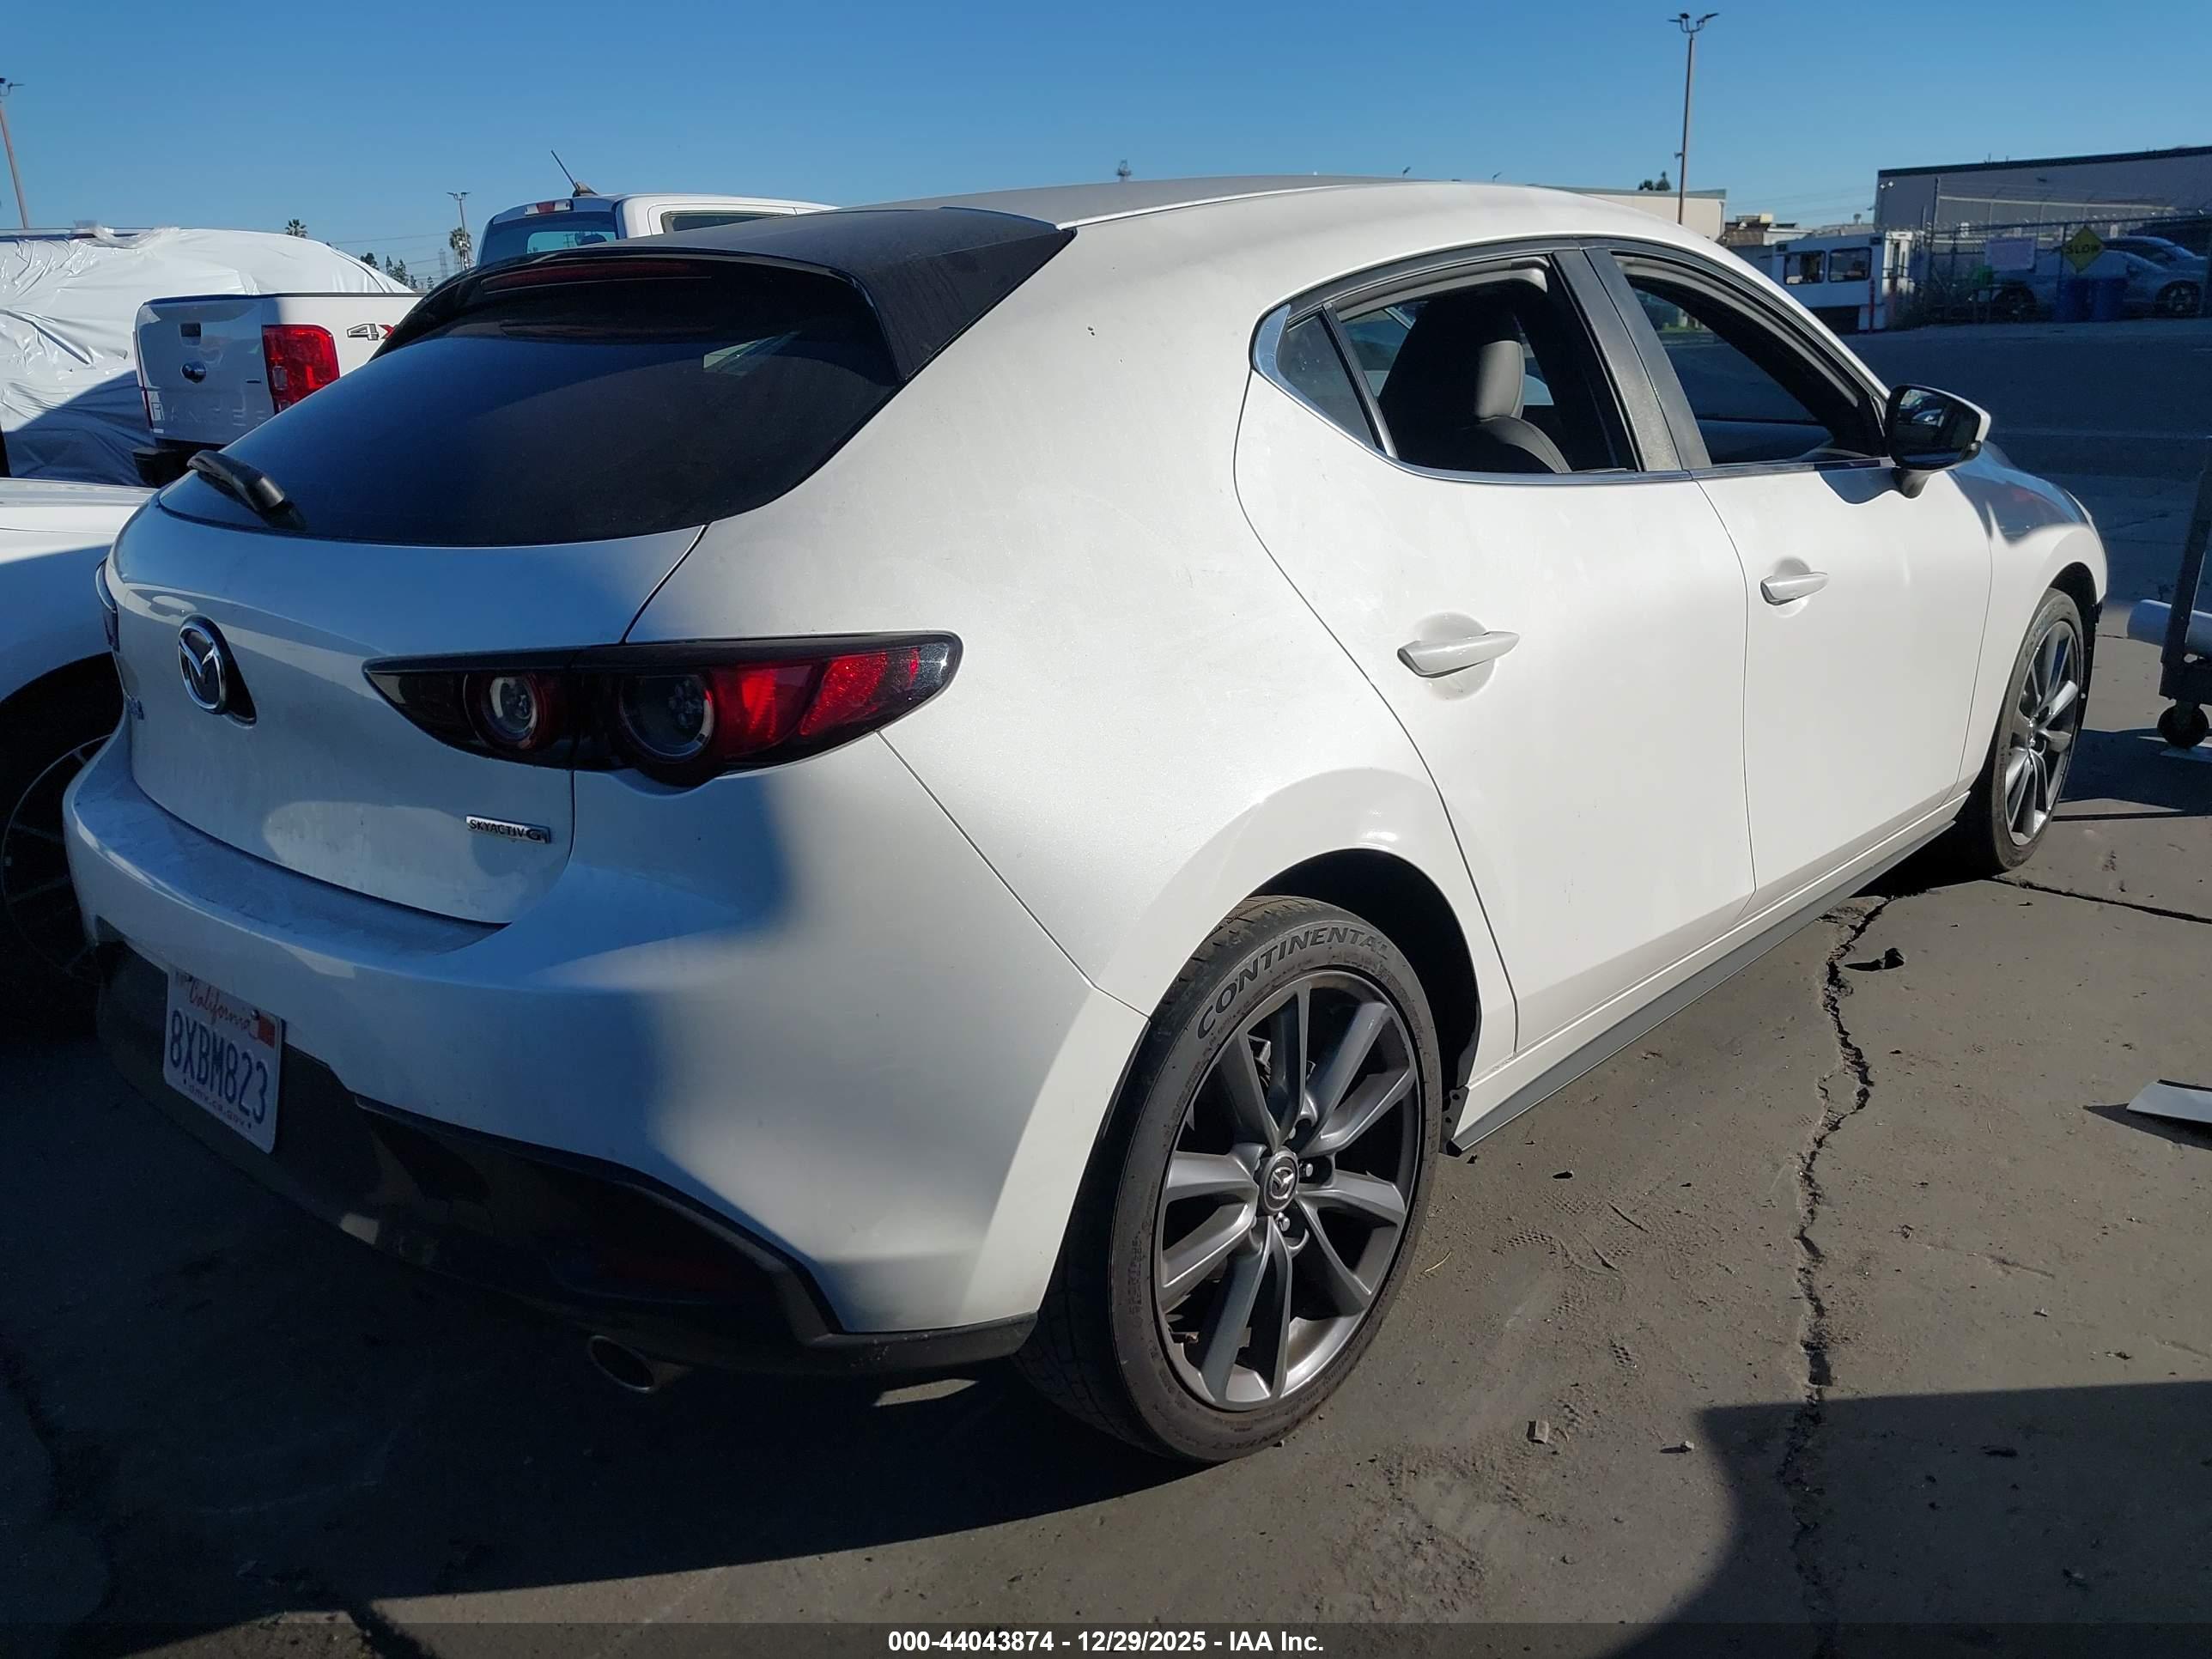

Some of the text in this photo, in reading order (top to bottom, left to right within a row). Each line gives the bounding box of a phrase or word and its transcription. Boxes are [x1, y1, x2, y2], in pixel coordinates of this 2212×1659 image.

[2066, 244, 2100, 255] SLOW
[188, 977, 252, 1031] California
[1196, 926, 1389, 1040] CONTINENTAL
[169, 1008, 268, 1125] 8XBM823
